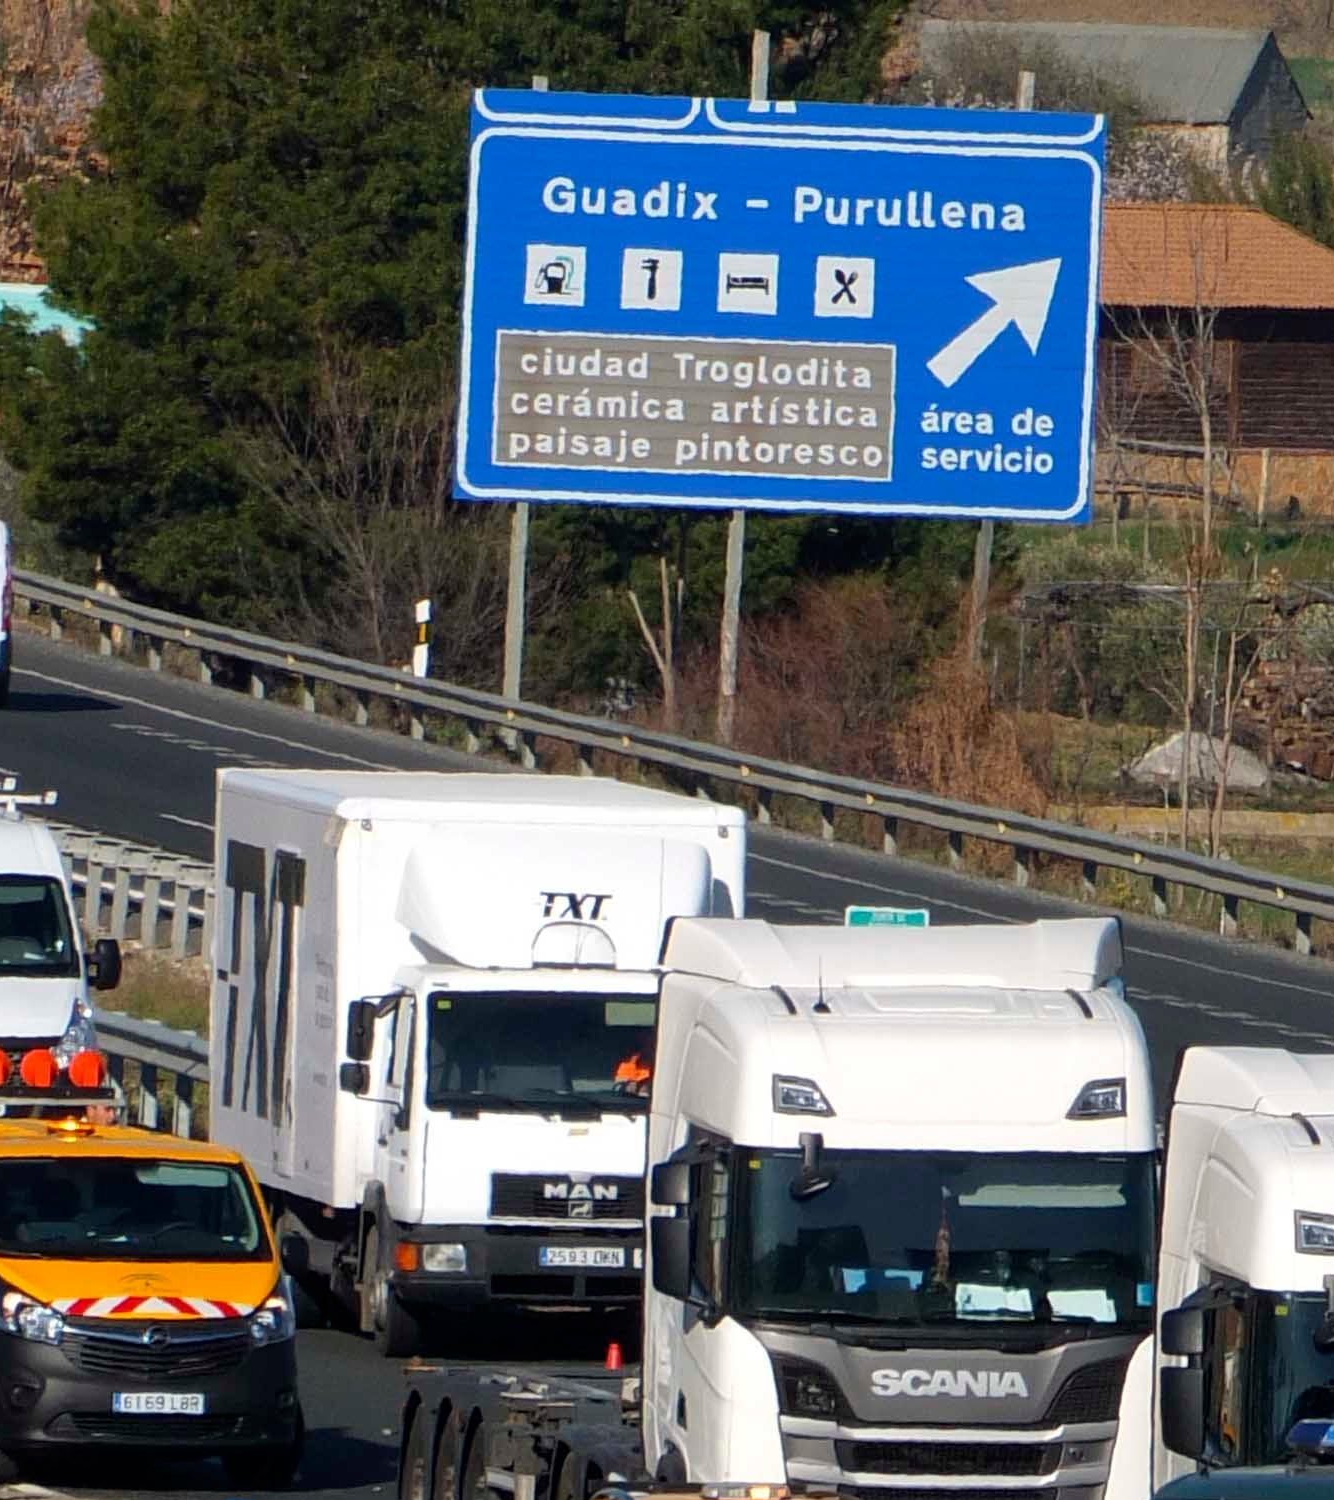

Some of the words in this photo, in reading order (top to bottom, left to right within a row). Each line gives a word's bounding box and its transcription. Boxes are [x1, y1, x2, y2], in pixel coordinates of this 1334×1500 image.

[542, 176, 718, 220] Guadix
[794, 186, 1026, 231] Purullena
[520, 347, 649, 379] ciudad
[675, 353, 872, 388] Troglodita
[510, 387, 685, 422] cerámica
[711, 395, 878, 428] artística
[920, 403, 995, 436] área
[1011, 407, 1054, 437] de
[509, 430, 651, 463] paisaje
[675, 433, 883, 468] pintoresco
[921, 442, 1053, 475] servicio
[540, 891, 612, 920] TXT
[543, 1183, 618, 1200] MAN
[870, 1368, 1030, 1398] SCANIA
